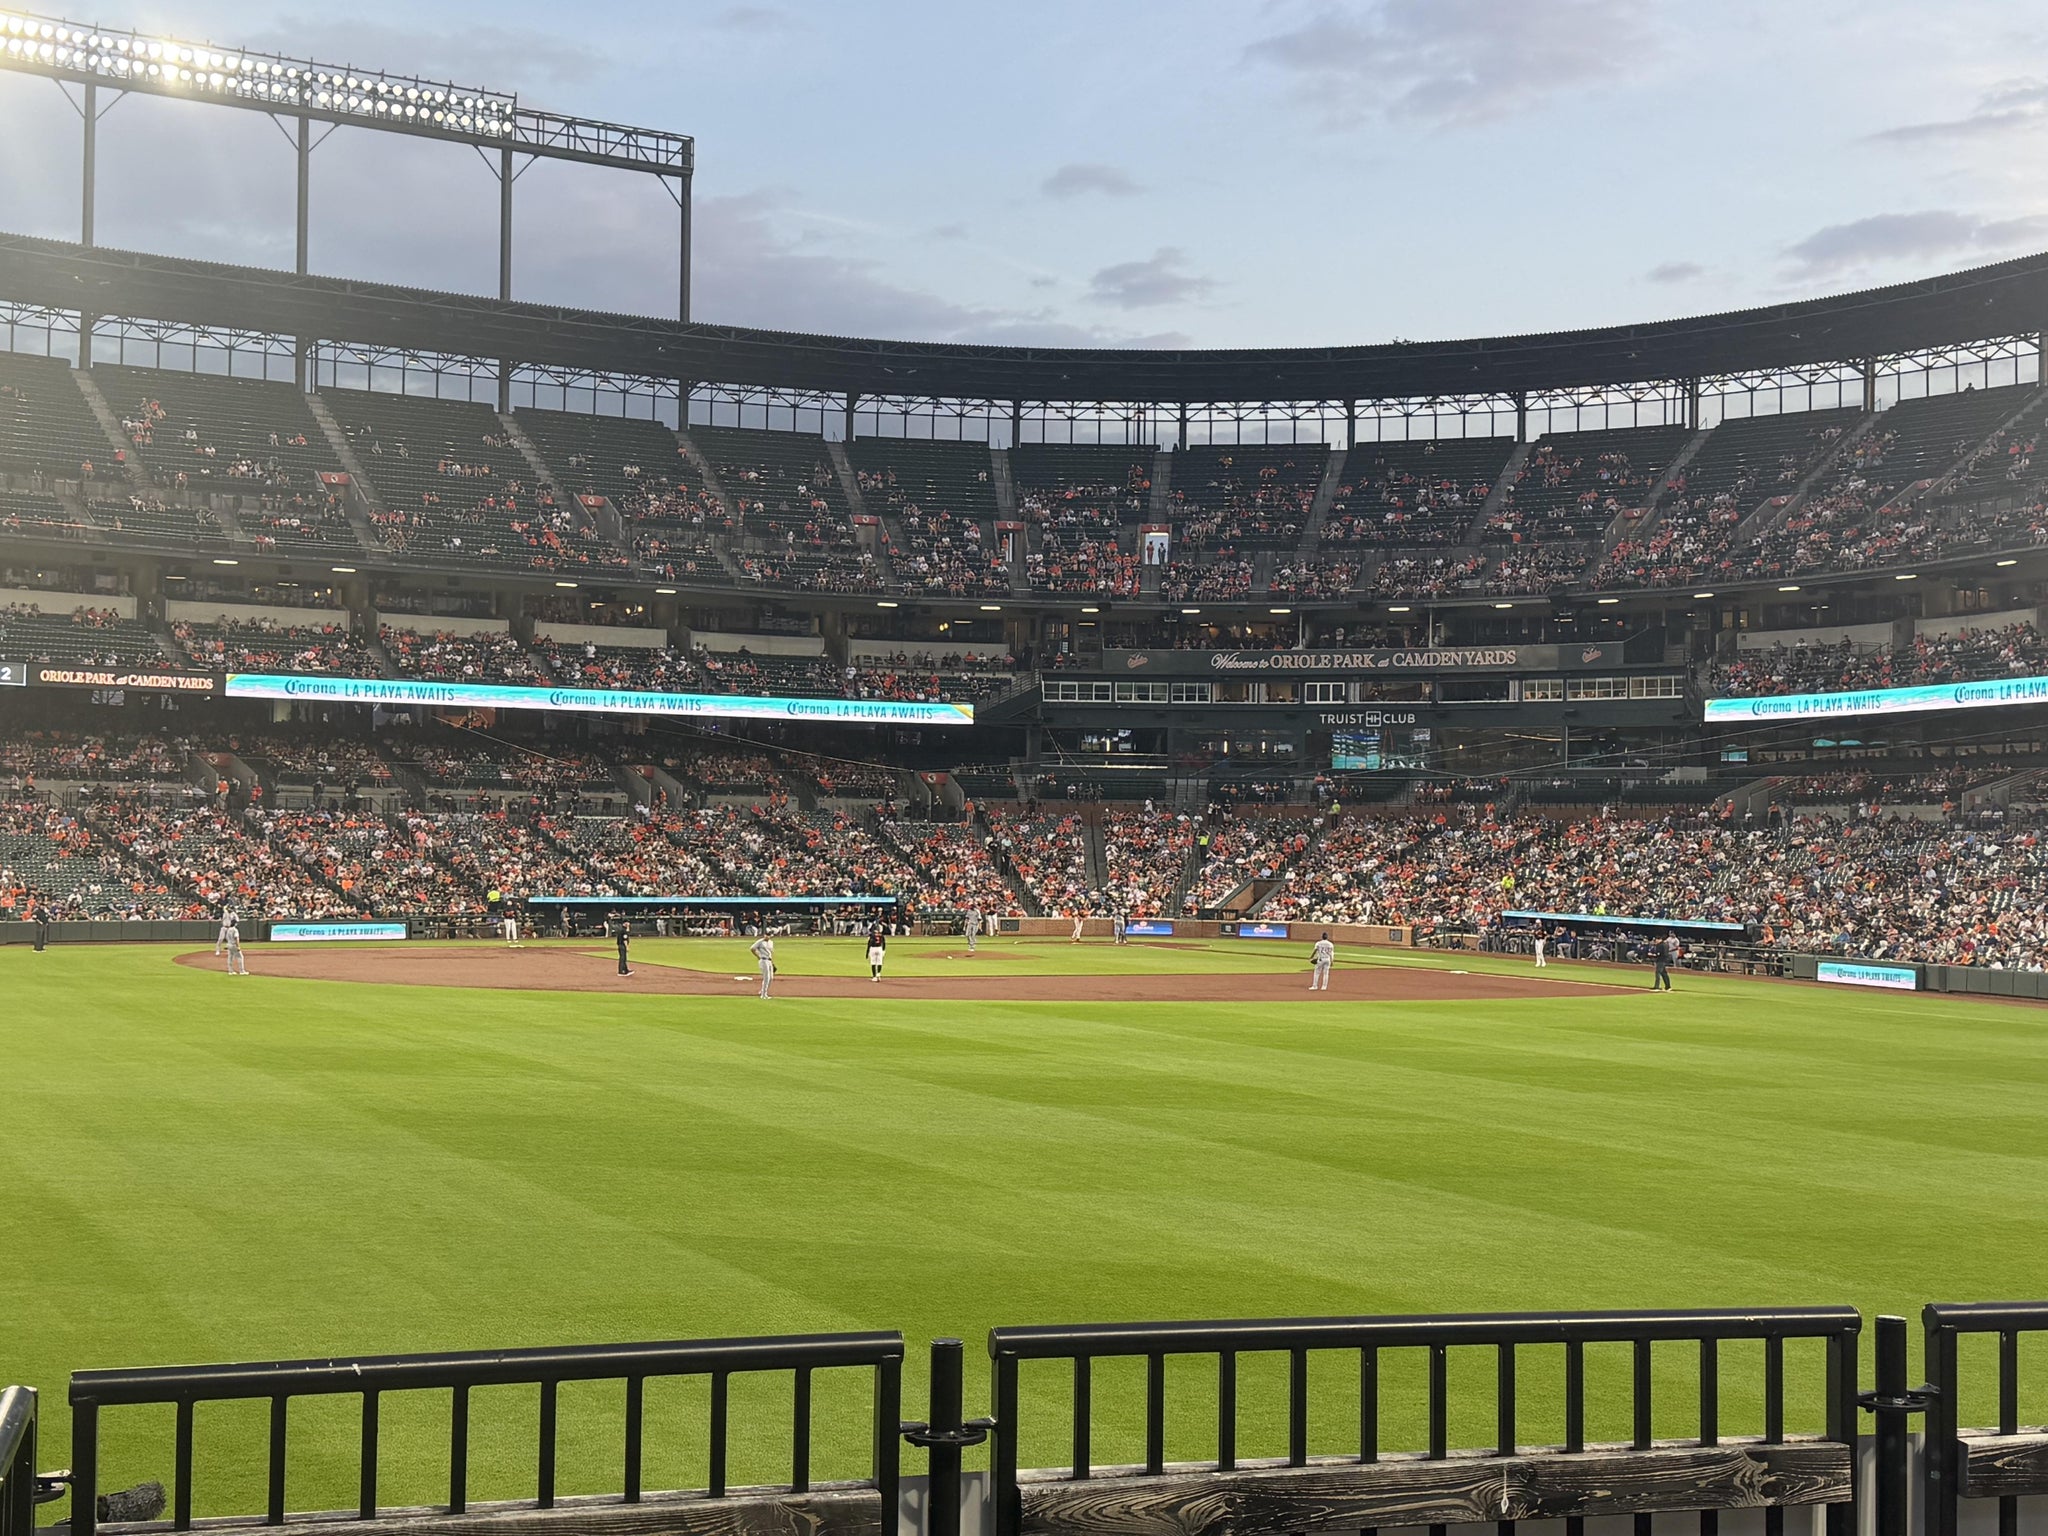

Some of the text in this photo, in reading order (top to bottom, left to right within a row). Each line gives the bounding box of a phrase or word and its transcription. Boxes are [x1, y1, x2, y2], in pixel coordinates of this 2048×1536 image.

[1211, 652, 1258, 669] Welcome
[1259, 659, 1270, 669] to
[1270, 654, 1331, 669] ORIOLE
[1333, 653, 1375, 668] PARK
[1392, 652, 1461, 667] CAMDEN
[1462, 650, 1516, 665] YARDS
[0, 667, 11, 680] 2
[40, 669, 85, 684] ORIOLE
[85, 671, 115, 685] PARK
[128, 674, 178, 688] CAMDEN
[177, 676, 213, 689] YARDS
[284, 679, 455, 701] Corona LA PLAYA AWAITS
[1954, 682, 2047, 704] Corona LA PLAYA
[550, 691, 702, 711] Corona LA PLAYA AWAITS
[787, 701, 933, 719] Corona LA PLAYA AWAITS
[1751, 695, 1881, 716] Corona LA PLAYA AWAITS
[1320, 714, 1416, 724] TRUIST CLUB
